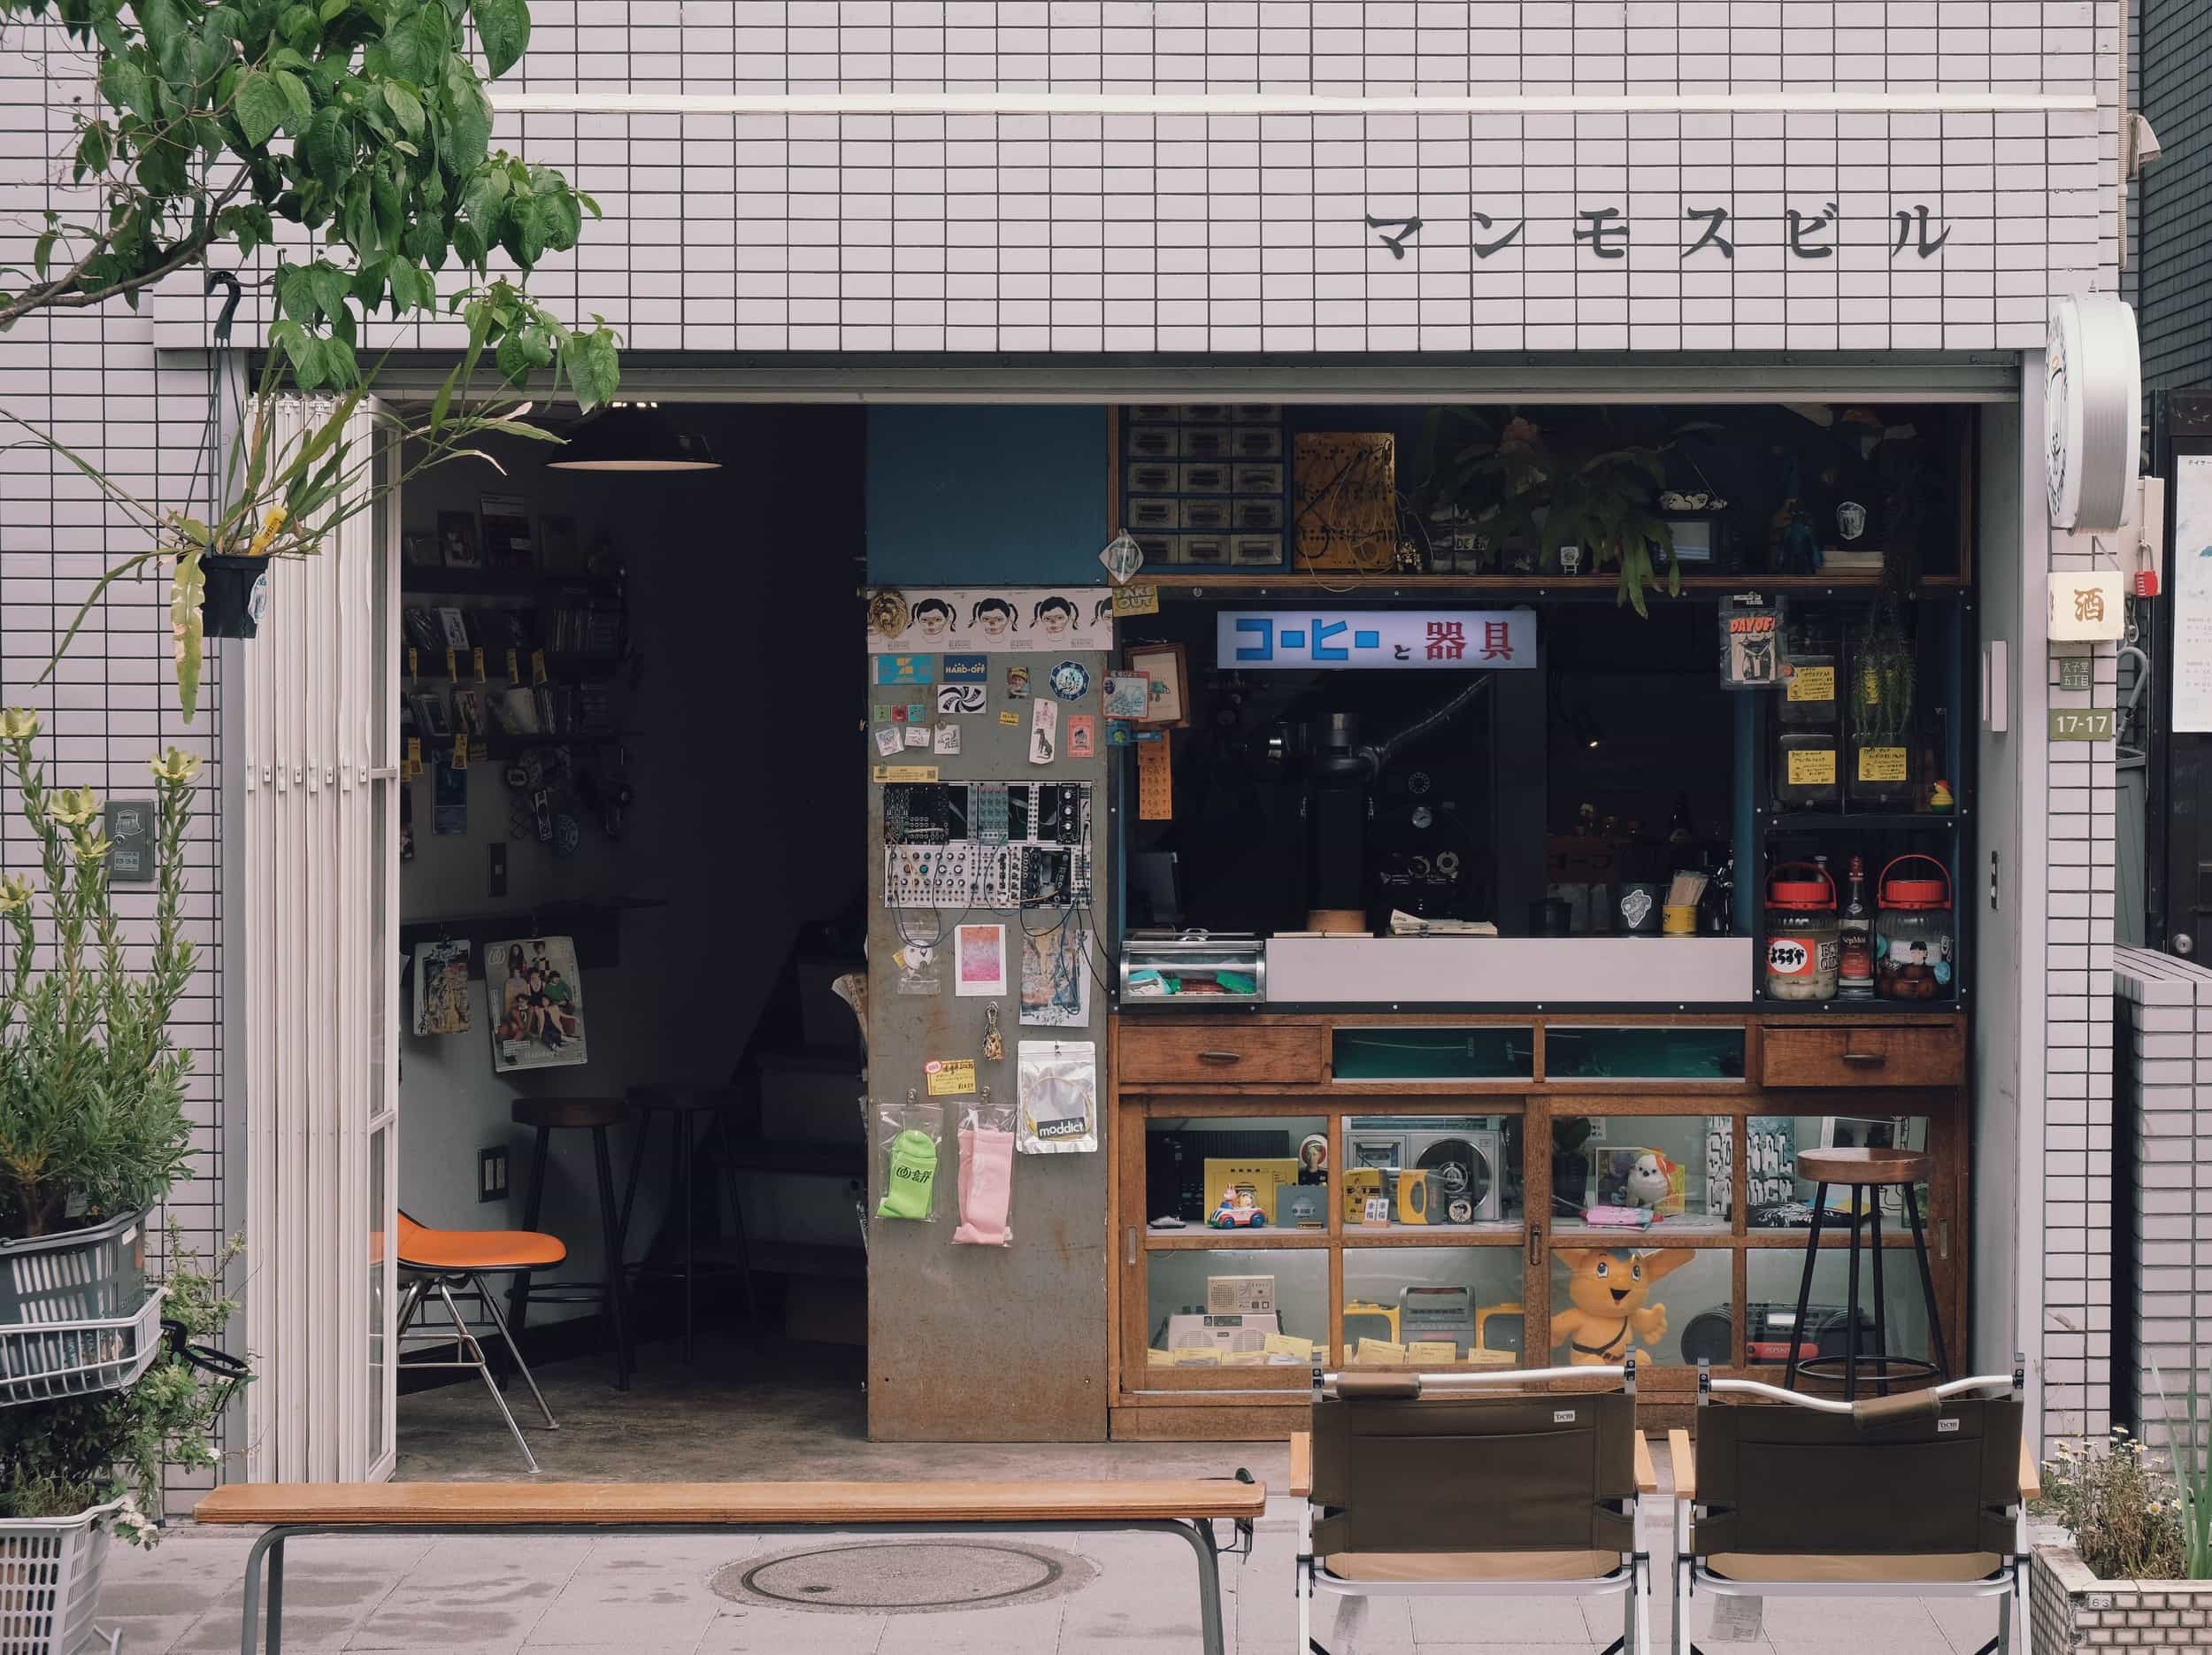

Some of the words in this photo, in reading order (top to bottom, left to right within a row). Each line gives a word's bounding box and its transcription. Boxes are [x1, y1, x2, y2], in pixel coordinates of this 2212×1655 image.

[1365, 202, 1952, 260] マンモスビル
[2073, 587, 2105, 622] 酒
[1235, 619, 1515, 660] コーヒーと器具
[2062, 662, 2089, 674] 太子堂
[2062, 674, 2089, 687] 五丁目
[2057, 716, 2108, 734] 17-17
[1039, 1123, 1085, 1138] moddict
